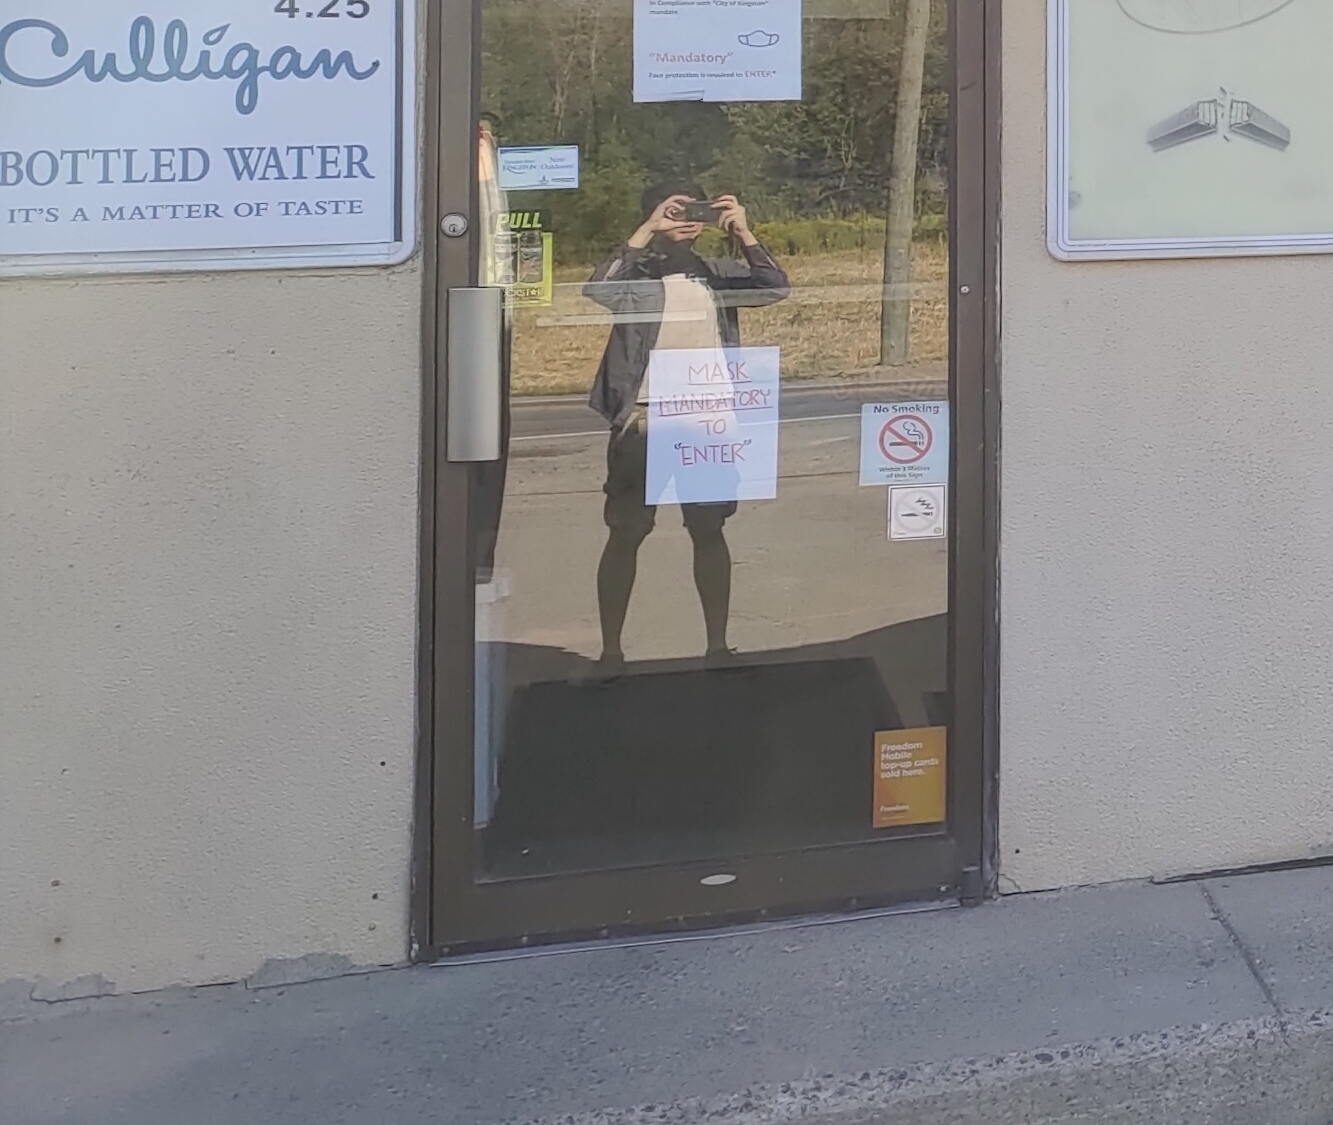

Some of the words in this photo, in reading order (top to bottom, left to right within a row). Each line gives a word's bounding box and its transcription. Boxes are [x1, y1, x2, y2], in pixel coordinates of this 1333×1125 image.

[0, 16, 380, 115] Culligan
[649, 52, 733, 64] "Mandatory"
[0, 146, 210, 187] BOTTLED
[224, 144, 375, 181] WATER
[7, 207, 59, 223] IT'S
[71, 207, 90, 221] A
[102, 203, 224, 221] MATTER
[234, 202, 268, 217] OF
[278, 199, 363, 216] TASTE
[497, 212, 542, 228] PULL
[688, 362, 749, 382] MASK
[658, 388, 771, 415] MANDATORY
[873, 405, 889, 414] No
[891, 404, 940, 414] Smoking
[698, 419, 726, 436] TO
[674, 438, 752, 466] "ENTER"
[881, 742, 923, 752] Freedom
[880, 760, 912, 770] top-up
[914, 758, 939, 767] cards
[881, 752, 913, 761] Mobile
[880, 769, 900, 779] sold
[902, 768, 925, 777] here.
